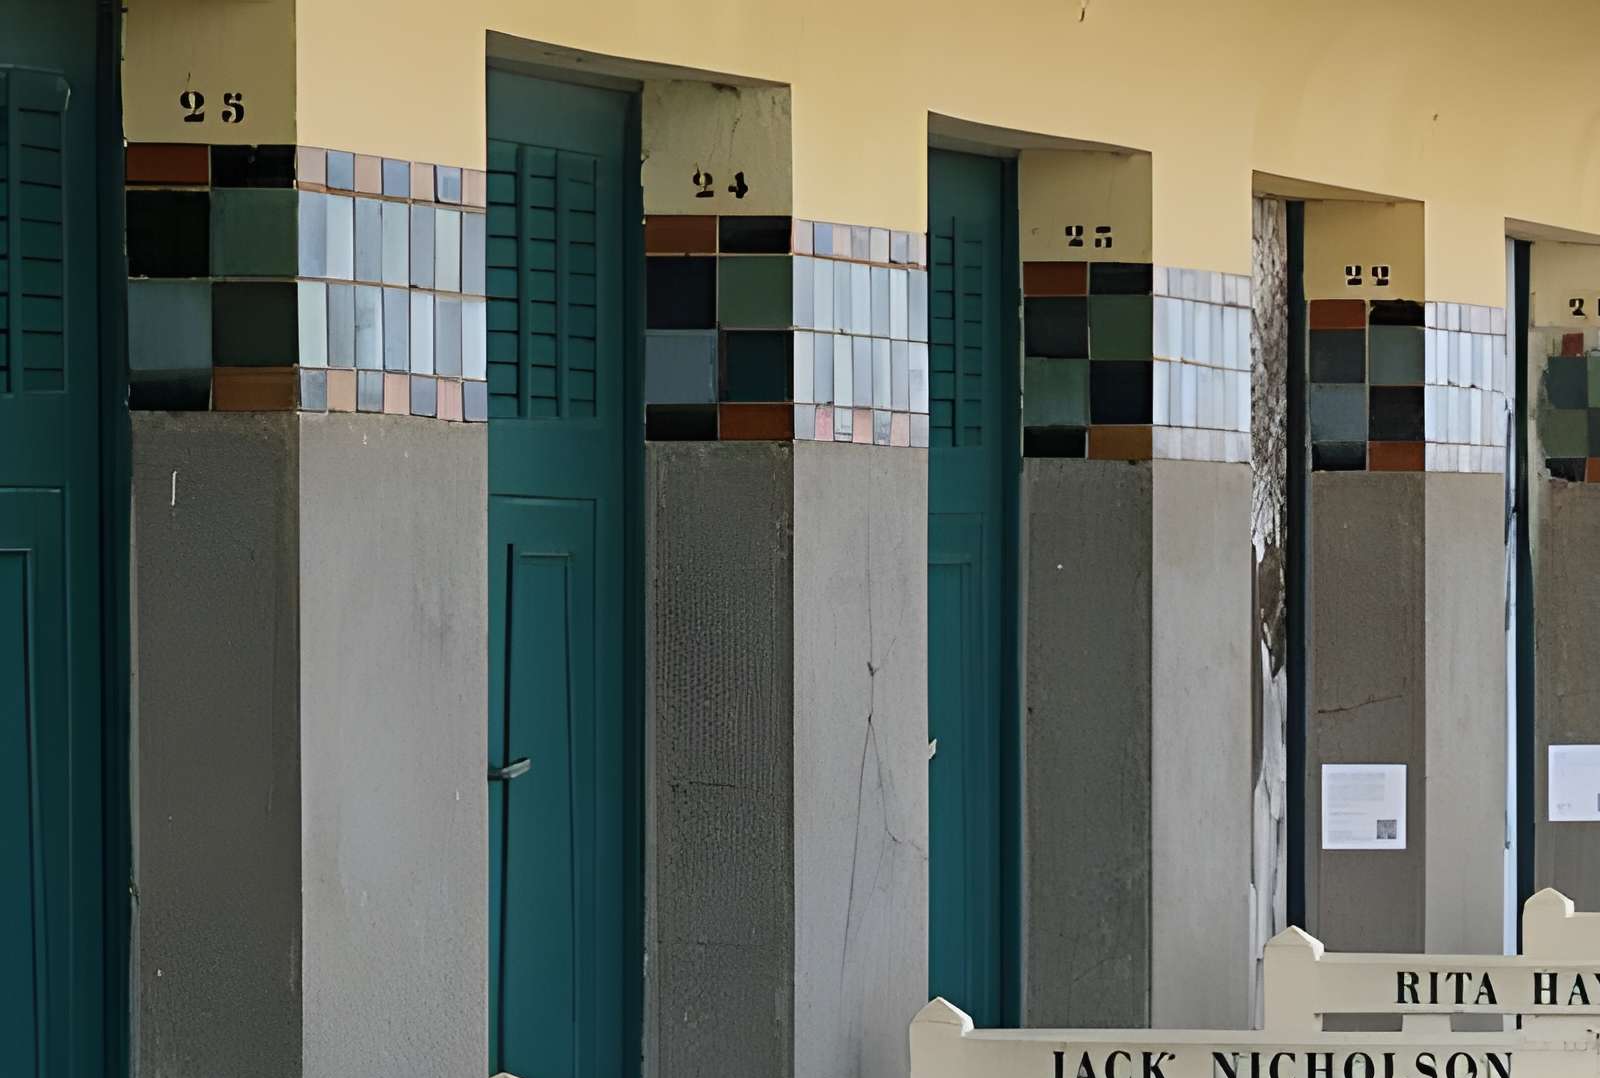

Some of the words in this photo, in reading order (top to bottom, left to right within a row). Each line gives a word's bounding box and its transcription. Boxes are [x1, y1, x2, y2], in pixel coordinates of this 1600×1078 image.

[179, 90, 245, 123] 25
[692, 169, 749, 199] 24
[1395, 970, 1498, 1005] RITA
